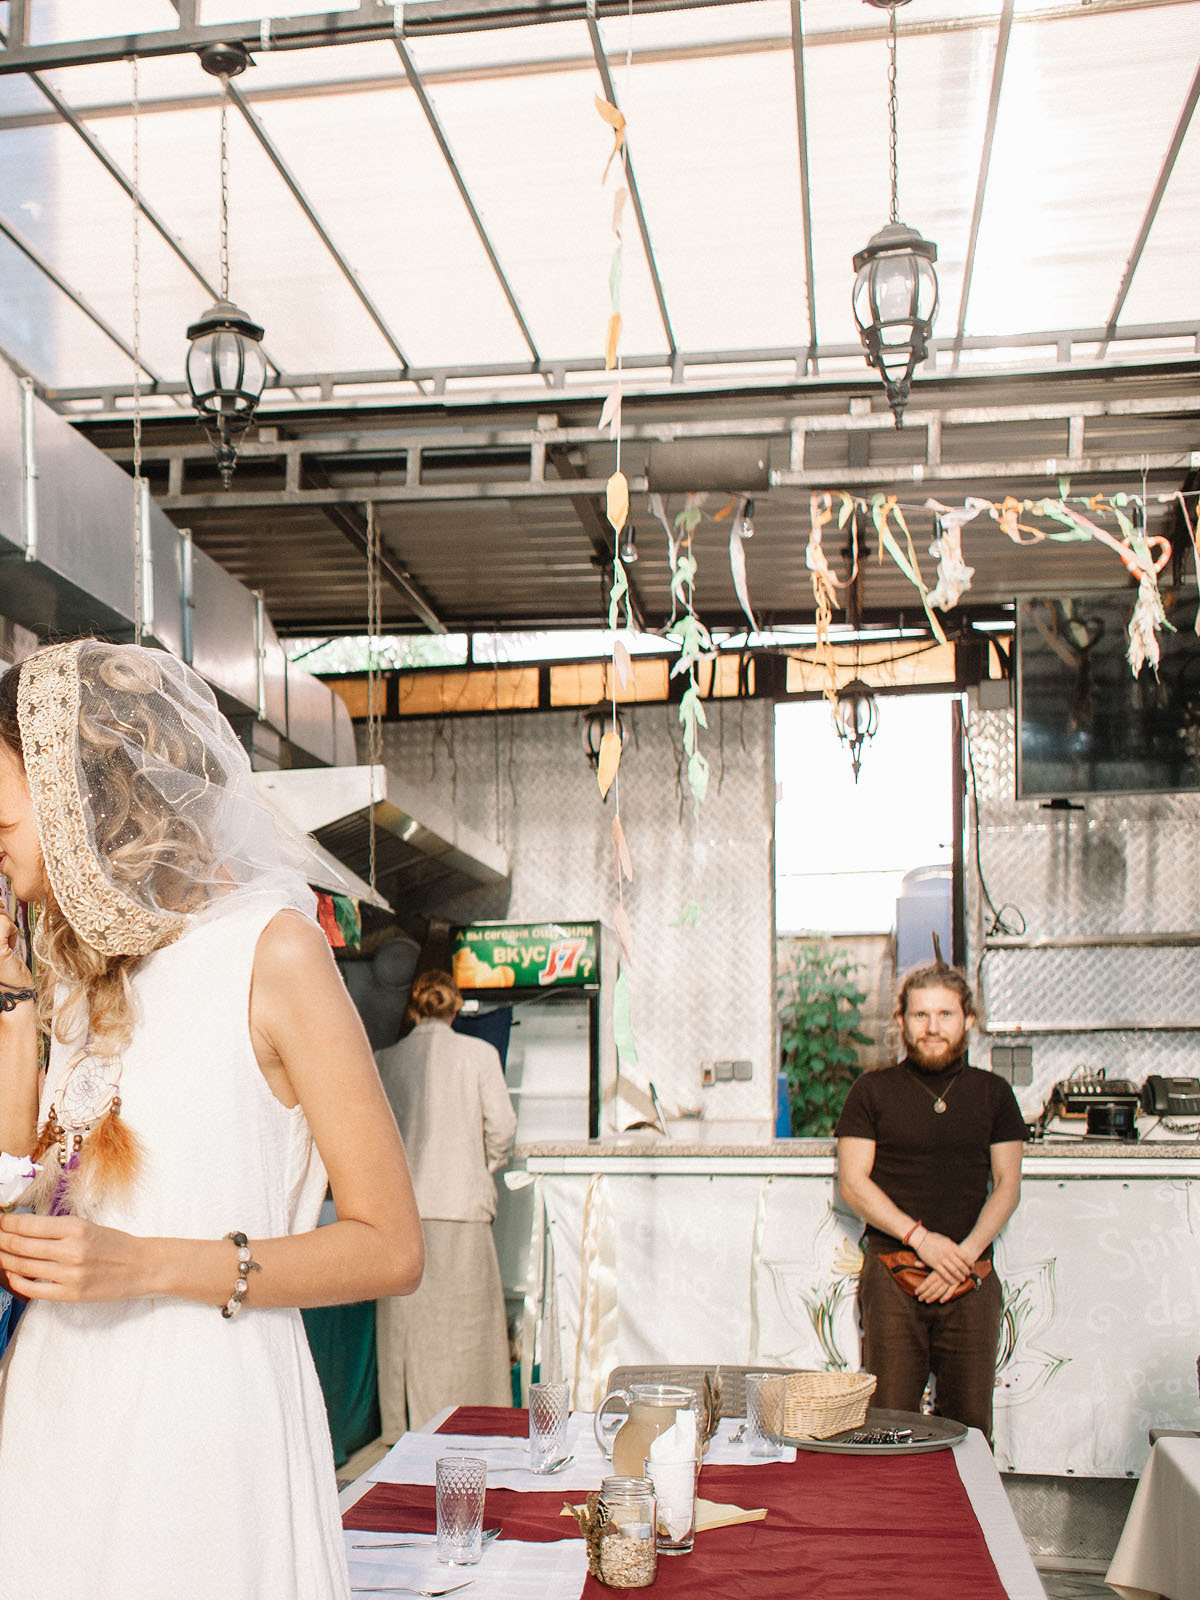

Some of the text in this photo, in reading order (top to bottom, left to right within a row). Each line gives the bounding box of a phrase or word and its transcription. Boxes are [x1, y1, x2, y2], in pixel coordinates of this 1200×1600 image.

[456, 926, 593, 942] А вы сегодня ощуили
